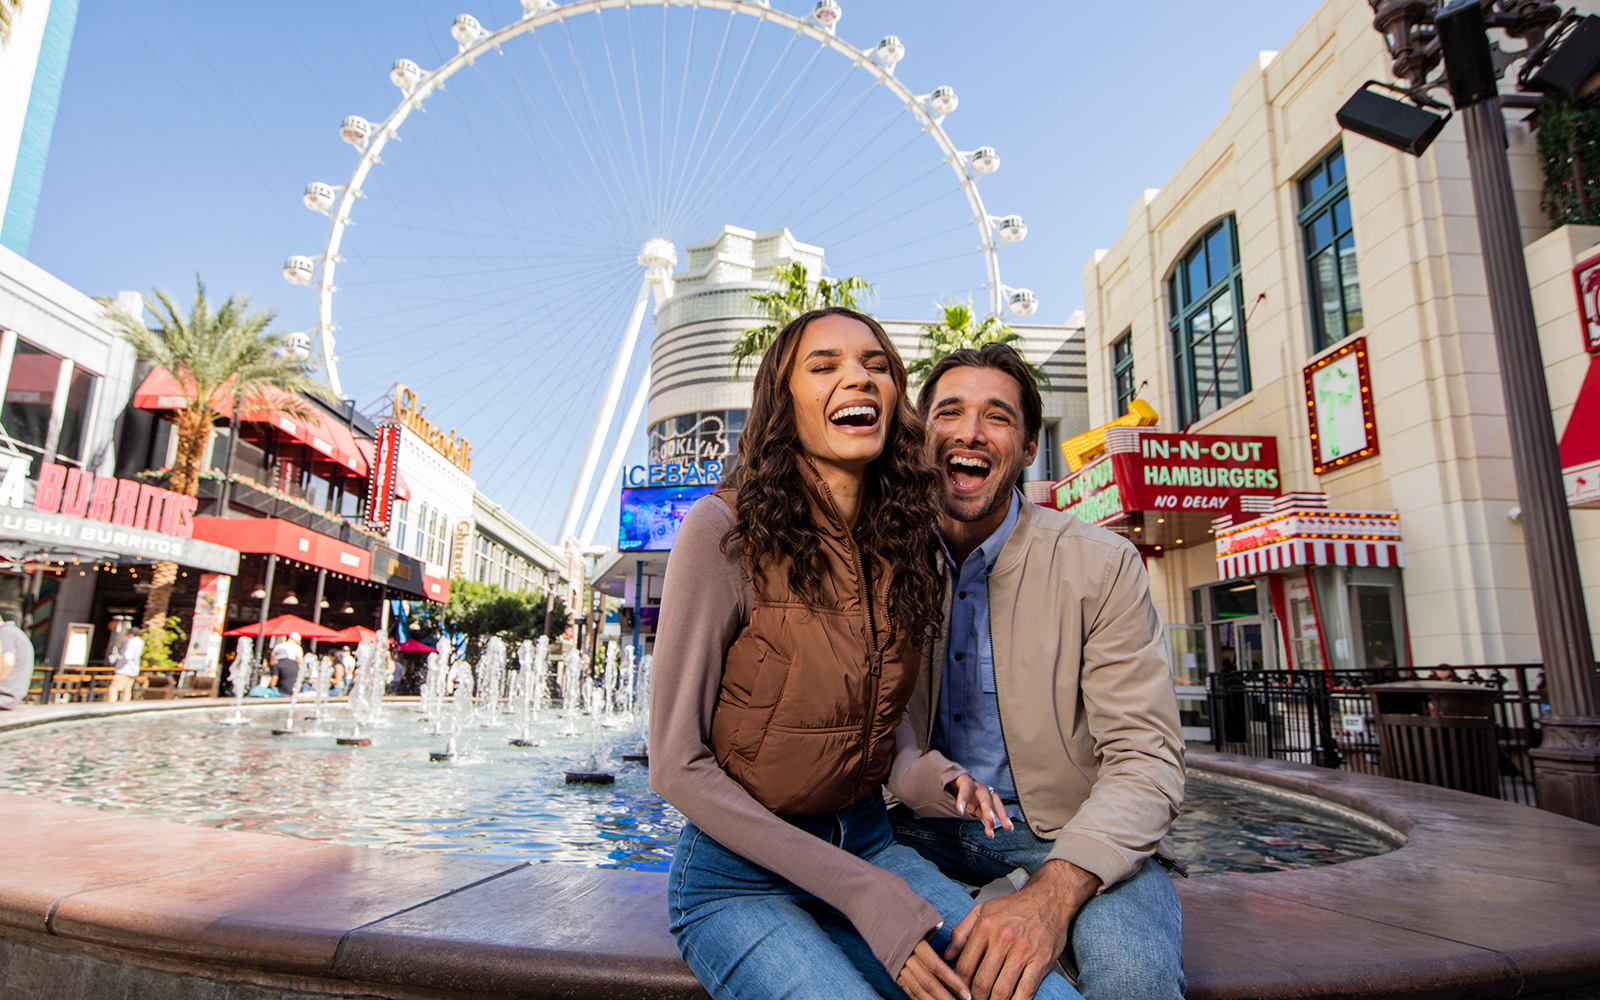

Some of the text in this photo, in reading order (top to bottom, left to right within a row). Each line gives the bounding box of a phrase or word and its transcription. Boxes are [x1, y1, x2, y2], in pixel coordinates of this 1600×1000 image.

[1142, 438, 1263, 462] IN-N-OUT
[373, 428, 390, 521] FAVORITE
[622, 460, 722, 487] ICEBAR
[1143, 464, 1279, 489] HAMBURGERS
[1154, 494, 1230, 510] NO DELAY
[0, 513, 183, 556] USHI BURRITOS
